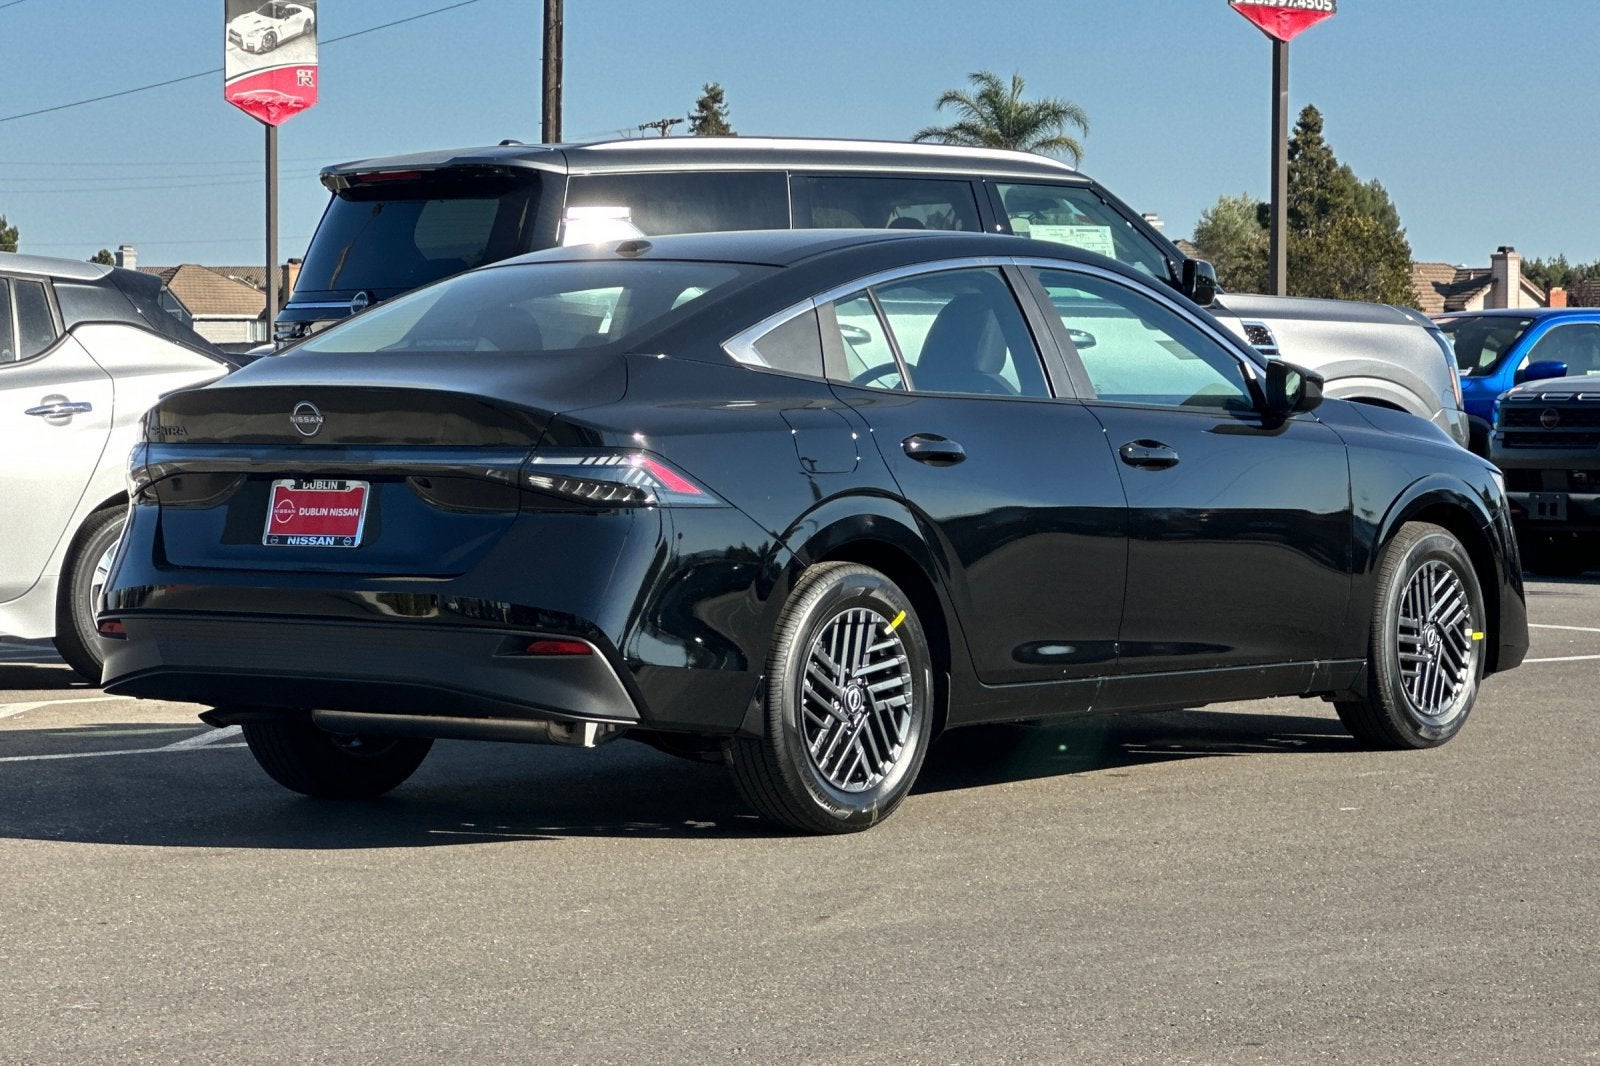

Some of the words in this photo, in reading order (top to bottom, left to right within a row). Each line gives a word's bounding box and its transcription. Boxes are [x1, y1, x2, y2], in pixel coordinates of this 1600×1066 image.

[302, 481, 338, 490] DUBLIN
[298, 507, 328, 516] DUBLIN
[329, 508, 359, 517] NISSAN
[287, 536, 335, 546] NISSAN
